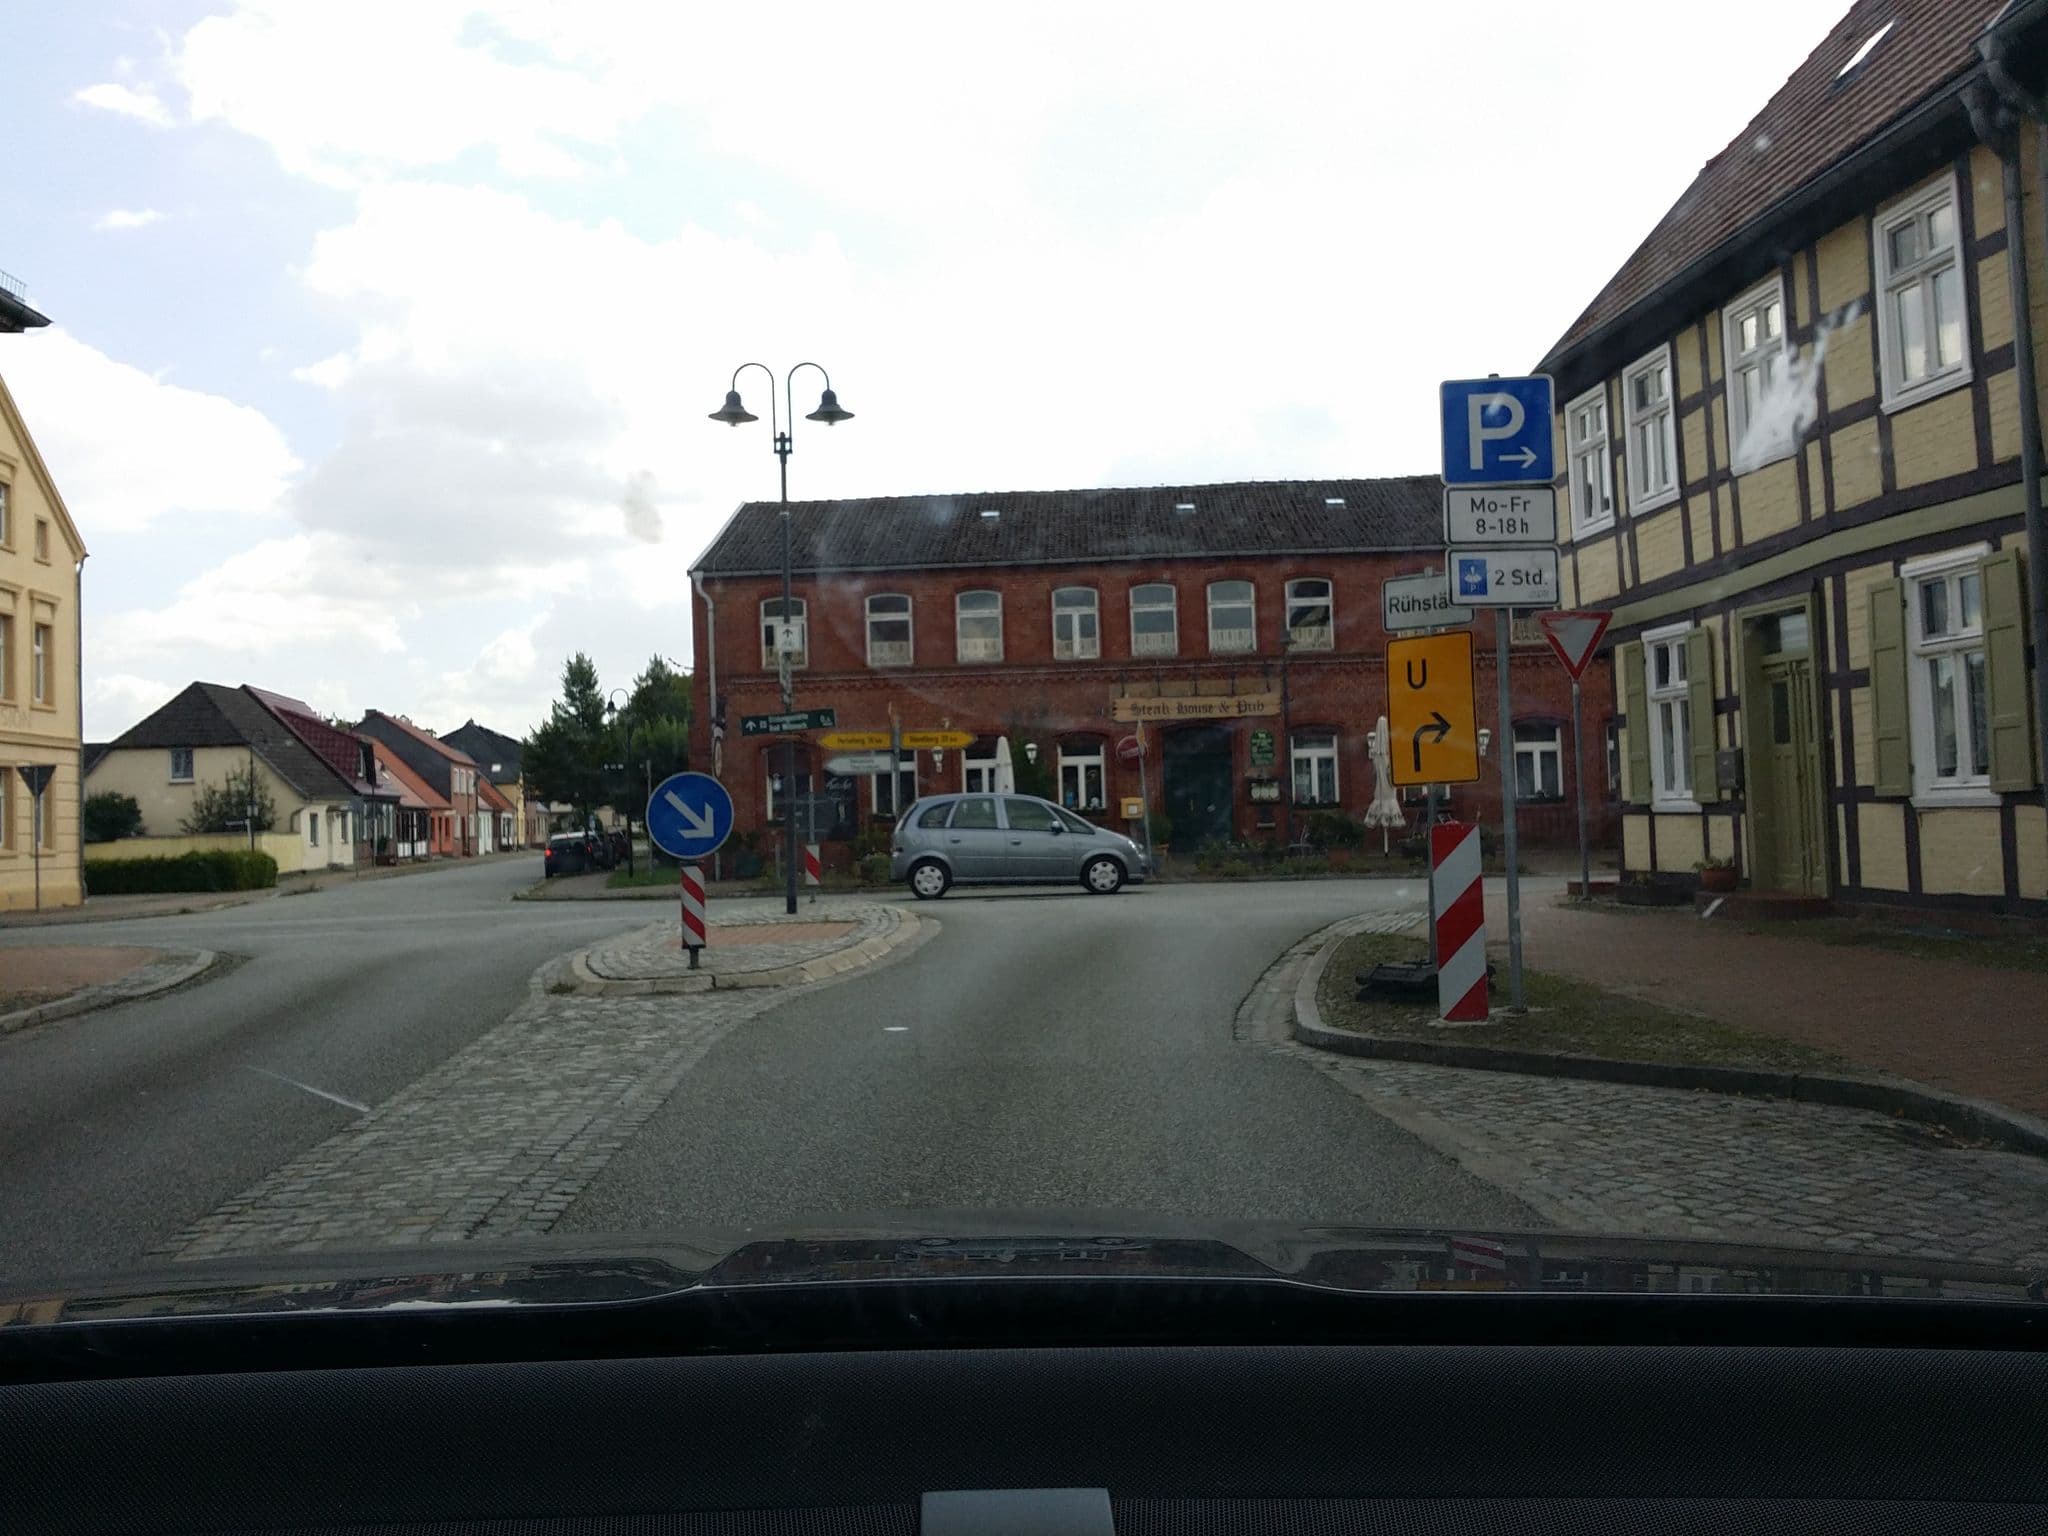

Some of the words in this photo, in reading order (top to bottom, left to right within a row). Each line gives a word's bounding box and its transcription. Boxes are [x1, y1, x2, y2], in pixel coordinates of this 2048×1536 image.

[1468, 393, 1525, 470] P
[1470, 496, 1531, 513] Mo-Fr
[1494, 569, 1505, 586] 2
[1511, 568, 1548, 586] Std.
[1389, 591, 1449, 614] Rühstä
[1406, 657, 1428, 690] U
